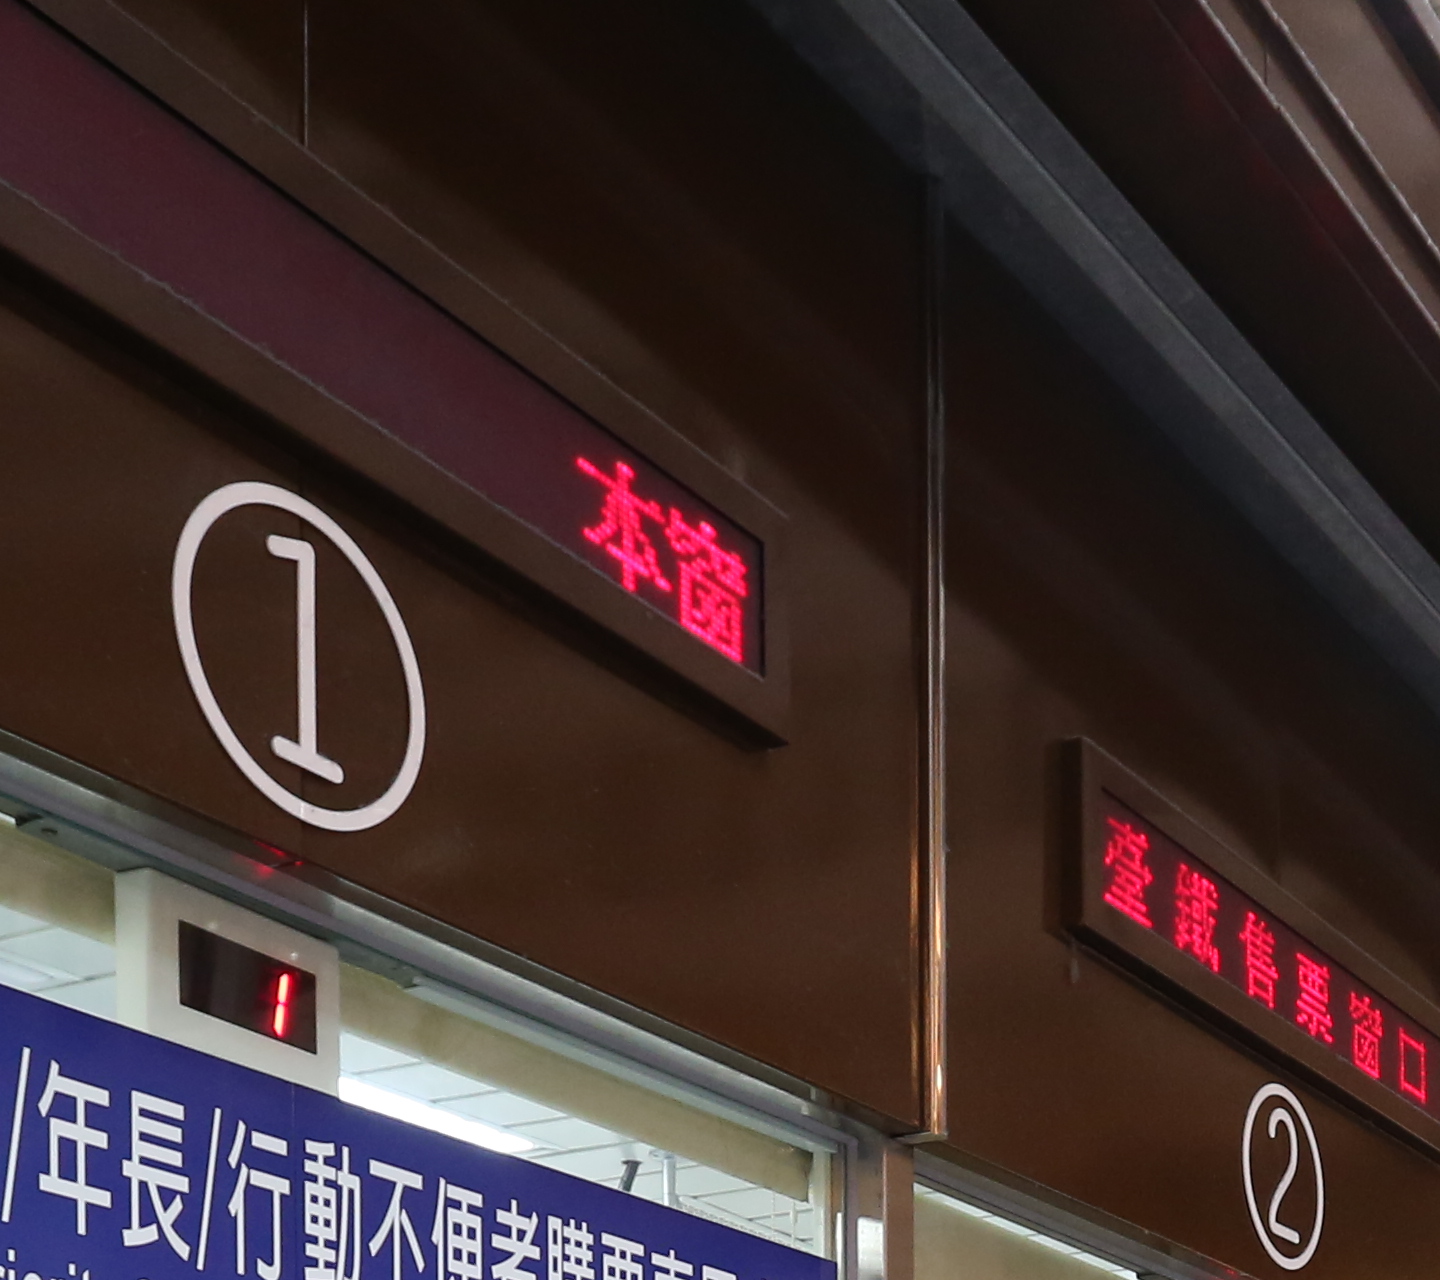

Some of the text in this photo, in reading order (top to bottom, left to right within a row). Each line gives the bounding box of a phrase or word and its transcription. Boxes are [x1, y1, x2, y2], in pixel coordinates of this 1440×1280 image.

[577, 455, 747, 661] 本窗
[266, 533, 344, 784] 1
[272, 971, 292, 1037] 1
[1268, 1107, 1300, 1244] 2
